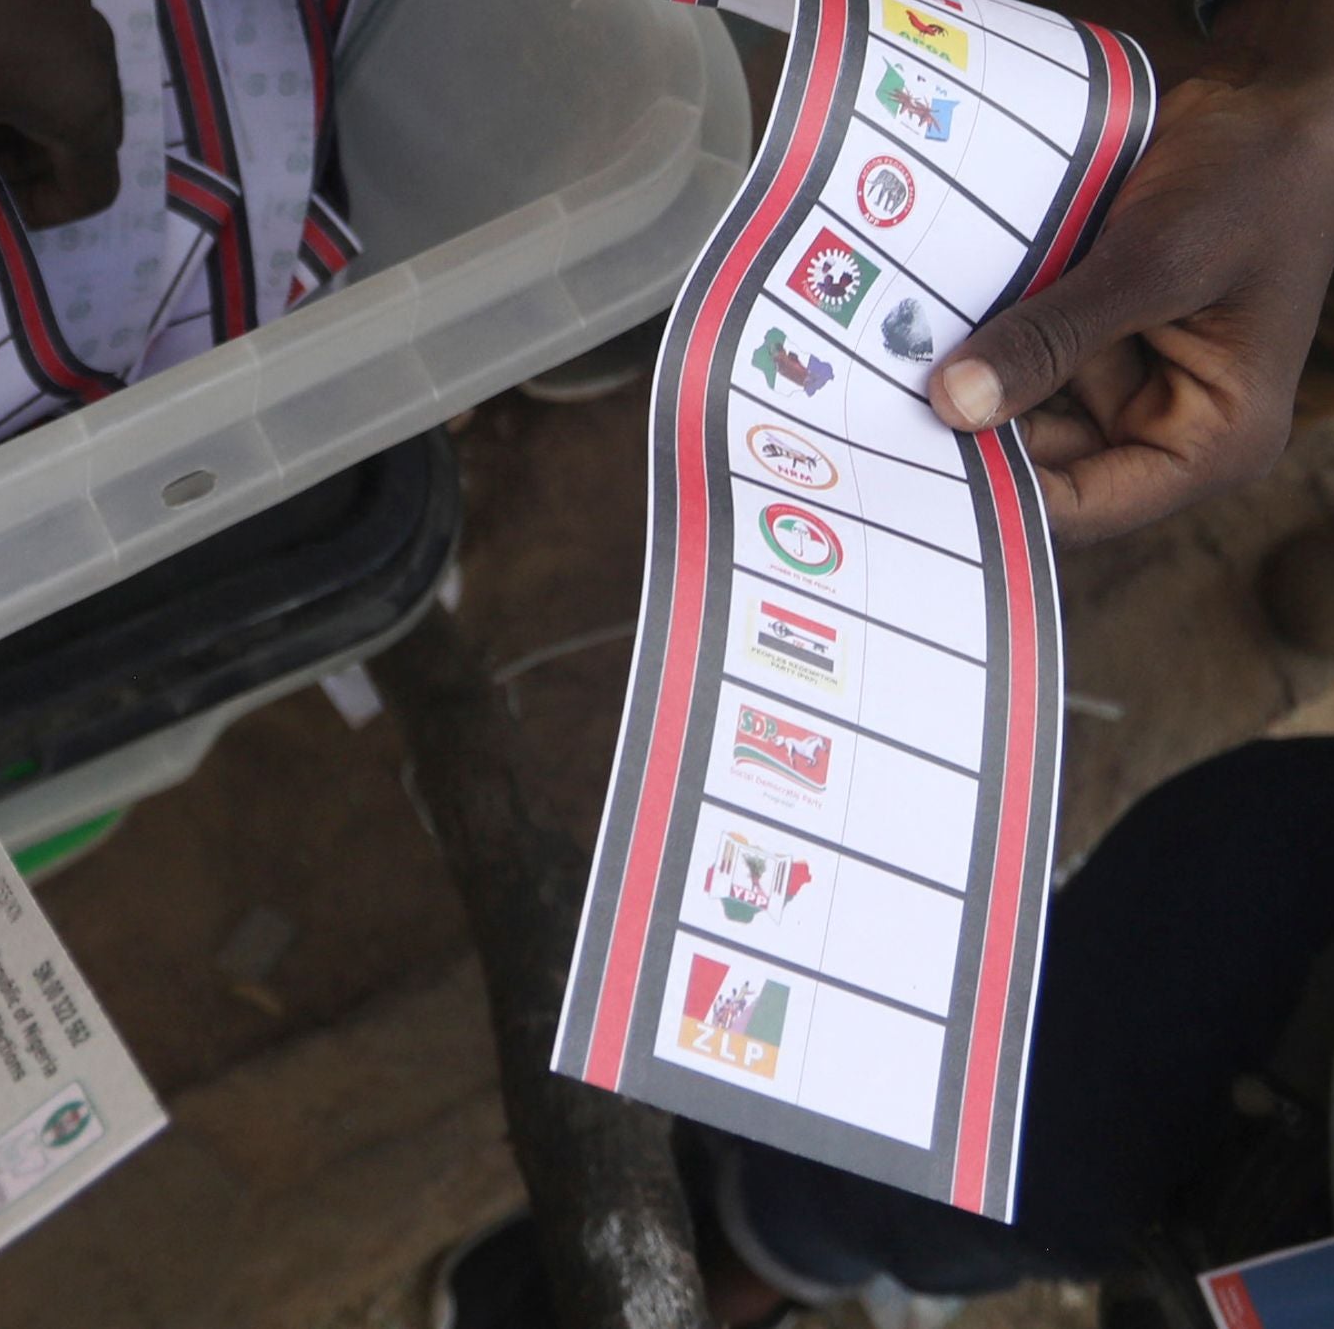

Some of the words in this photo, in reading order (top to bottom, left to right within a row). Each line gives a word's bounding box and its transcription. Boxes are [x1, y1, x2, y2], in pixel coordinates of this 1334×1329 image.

[899, 31, 952, 63] APGA
[864, 212, 880, 226] APP
[777, 464, 813, 484] NRM
[770, 661, 796, 677] PARTY
[789, 662, 838, 686] REDEMPTION
[740, 710, 778, 740] SDP
[755, 776, 801, 799] Democratic
[802, 792, 823, 809] Party
[732, 885, 767, 907] YPP
[14, 1006, 34, 1024] of
[23, 1022, 58, 1079] Nigeria
[692, 1022, 764, 1067] ZLP
